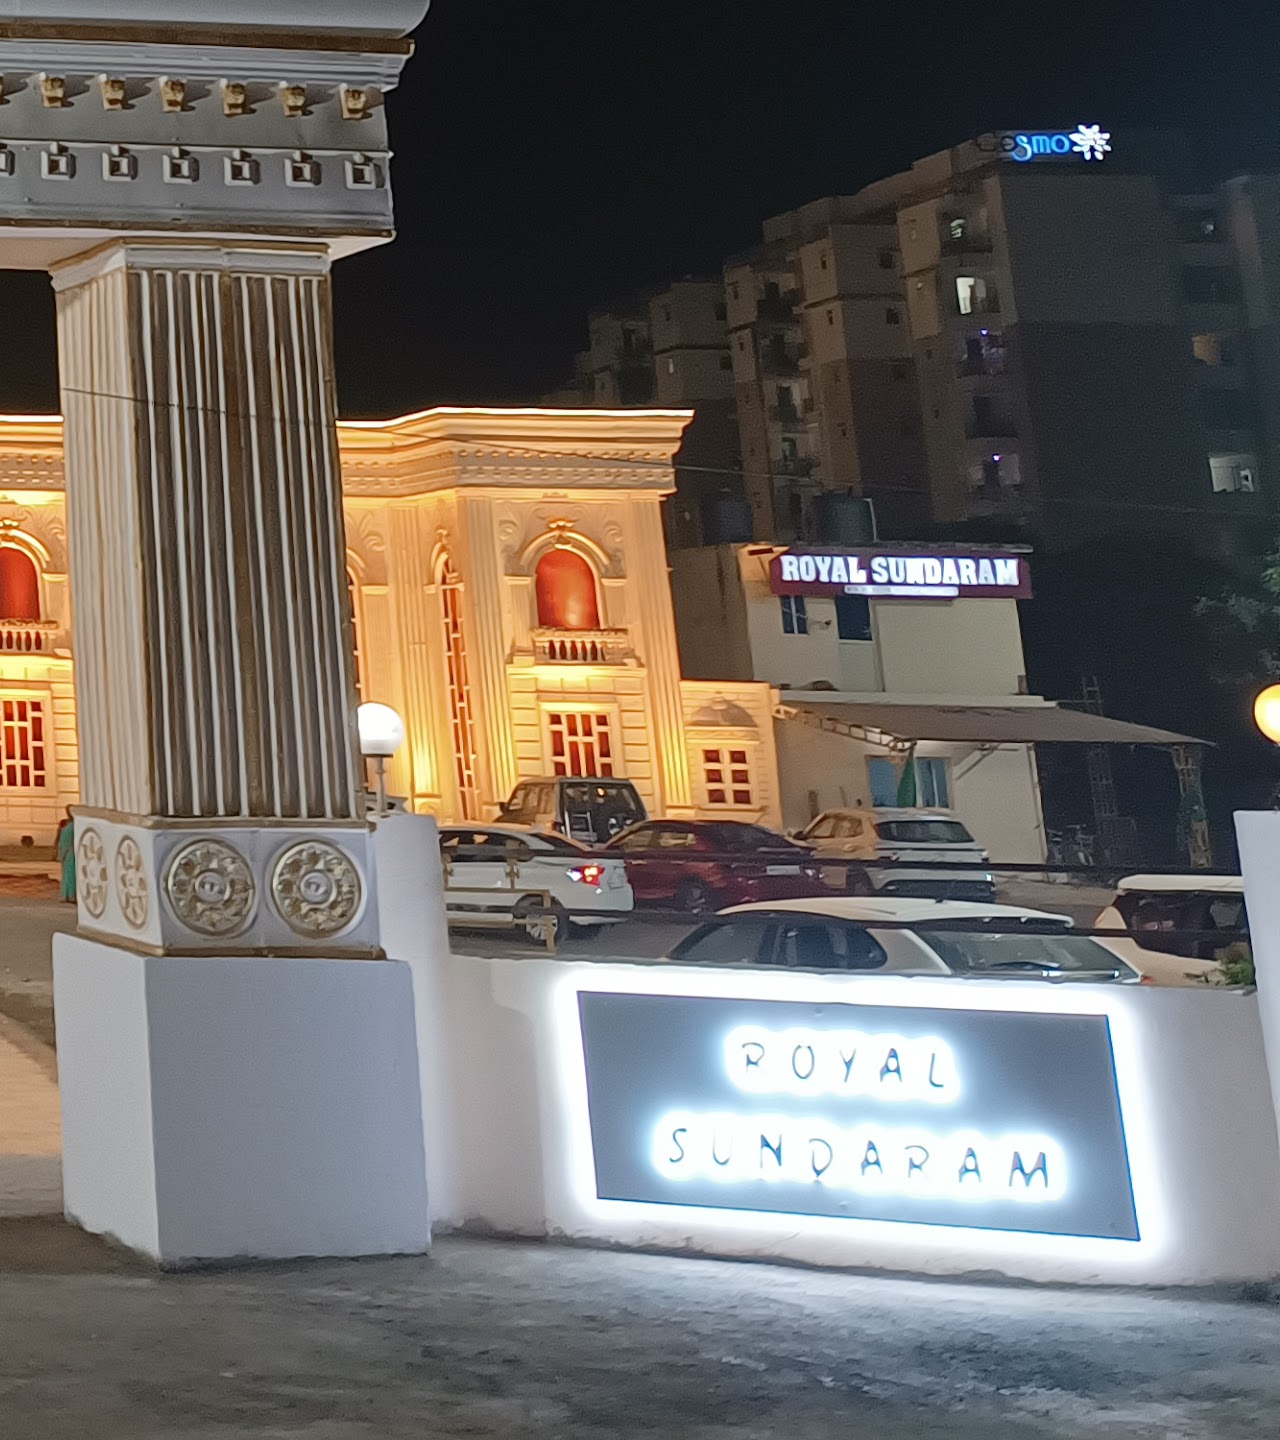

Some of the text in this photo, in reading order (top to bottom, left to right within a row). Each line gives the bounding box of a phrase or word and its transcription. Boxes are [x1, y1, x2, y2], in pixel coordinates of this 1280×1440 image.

[780, 554, 1020, 586] ROYAL SUNDARAM
[739, 1039, 947, 1091] ROYAL
[665, 1125, 1052, 1191] SUNDARAM
